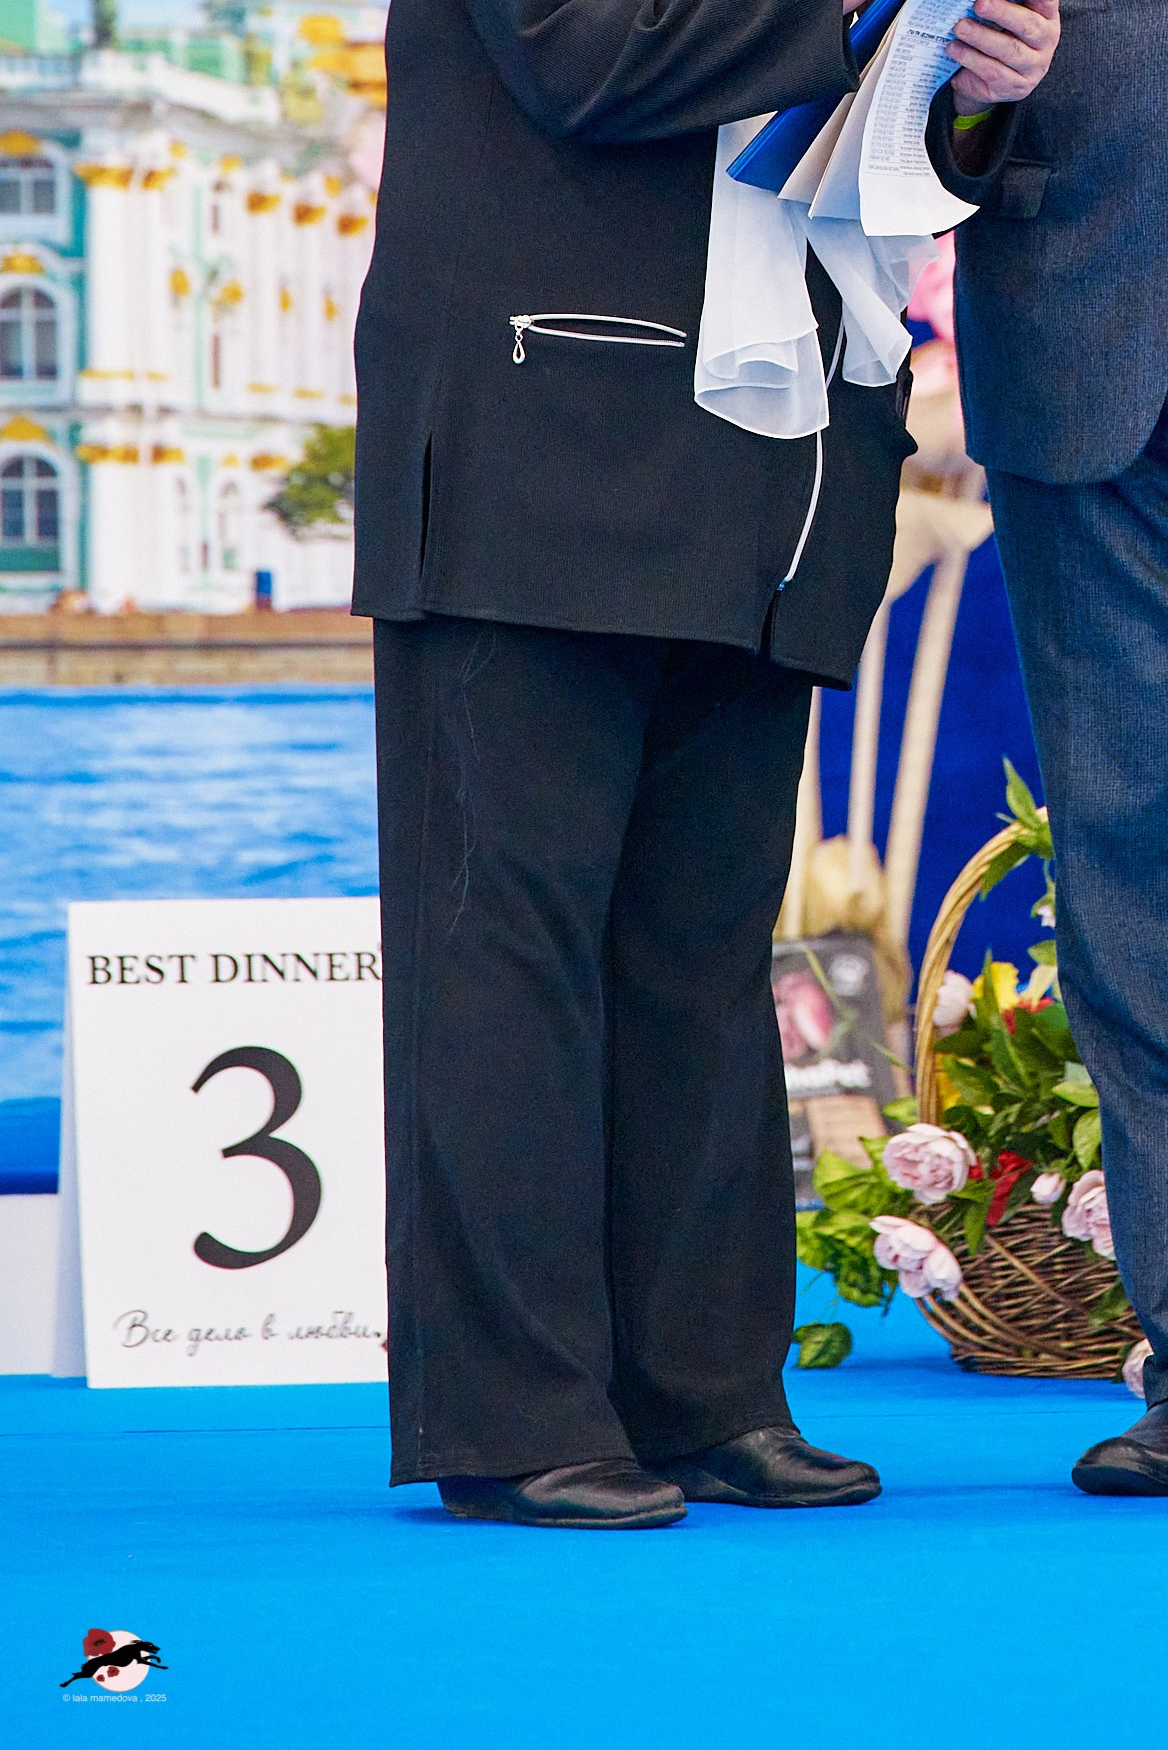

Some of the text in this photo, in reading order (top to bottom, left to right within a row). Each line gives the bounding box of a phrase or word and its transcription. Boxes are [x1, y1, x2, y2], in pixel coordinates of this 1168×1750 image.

[87, 952, 381, 985] BEST DINNER
[190, 1046, 323, 1270] 3
